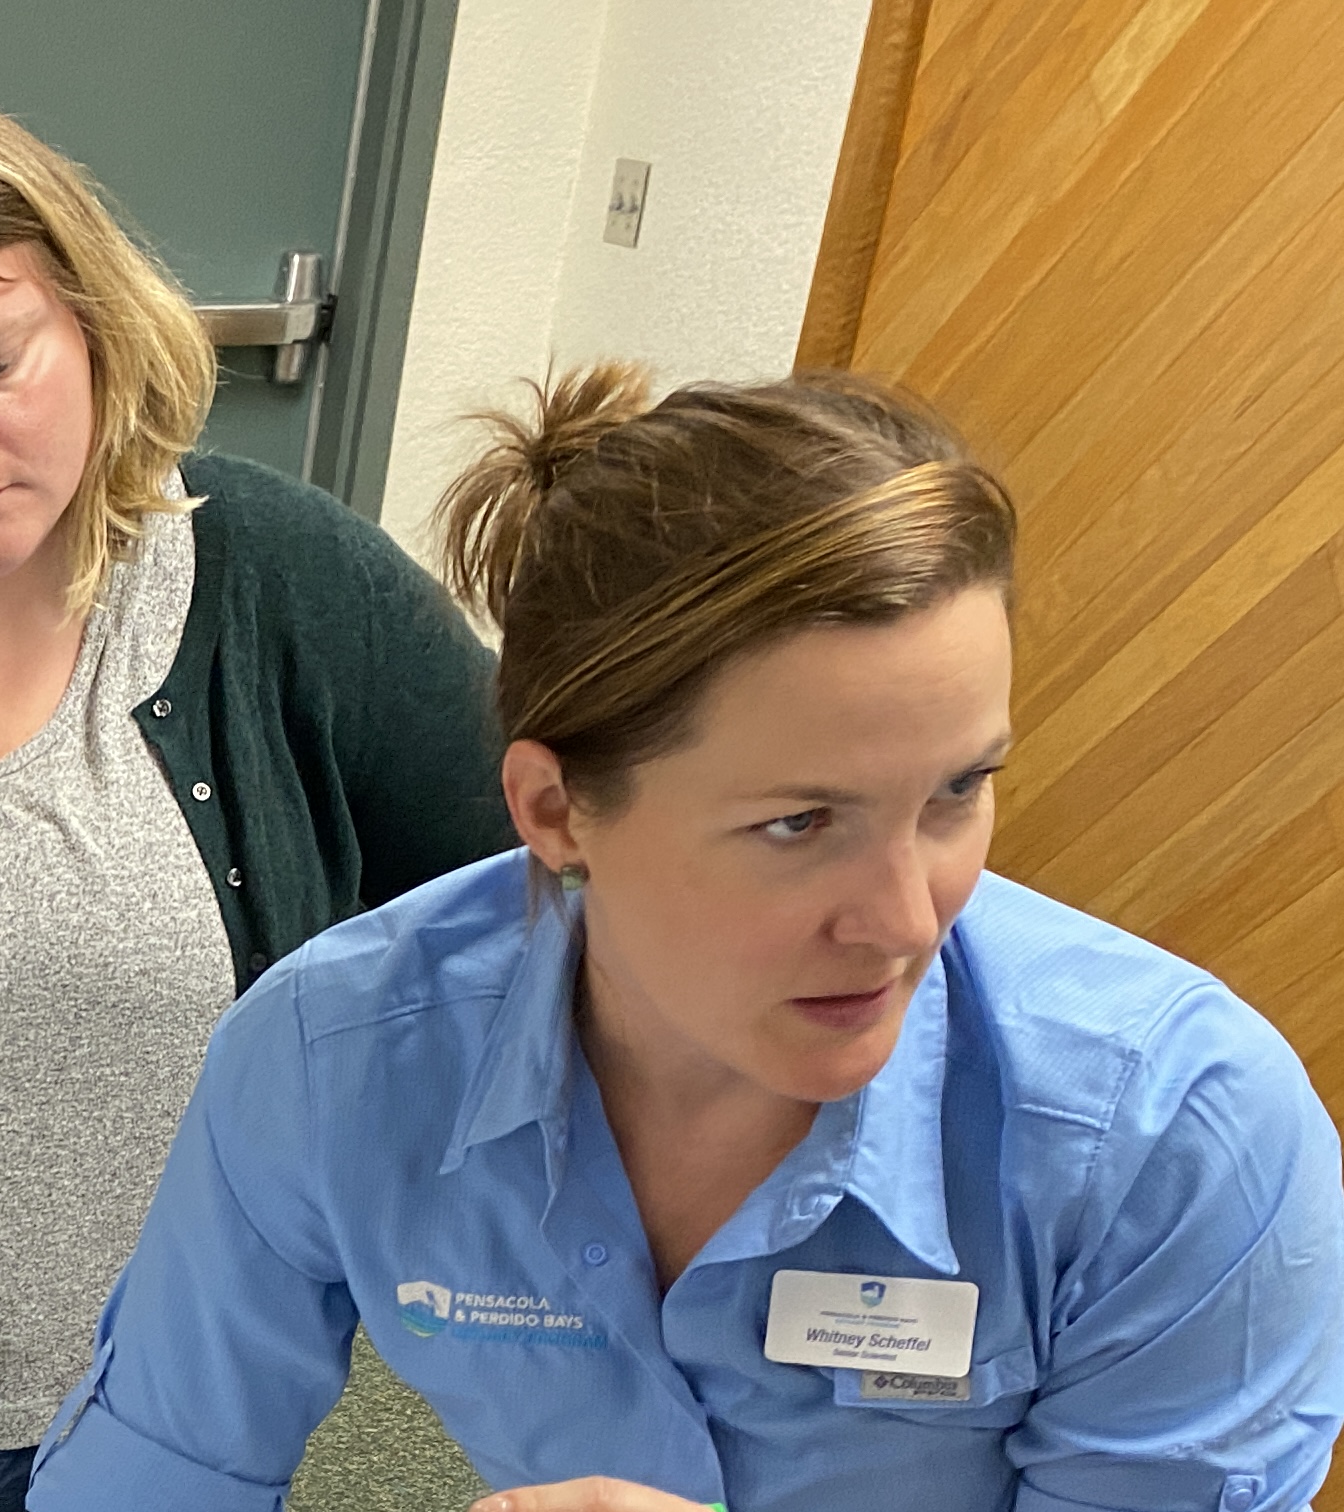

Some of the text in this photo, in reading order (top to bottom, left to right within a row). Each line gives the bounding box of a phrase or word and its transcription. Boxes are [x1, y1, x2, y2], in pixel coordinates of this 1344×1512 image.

[454, 1292, 550, 1311] PENSACOLA
[454, 1311, 583, 1329] & PERDIDO BAYS
[806, 1327, 932, 1351] Whitney Scheffel
[890, 1375, 958, 1390] Columbia
